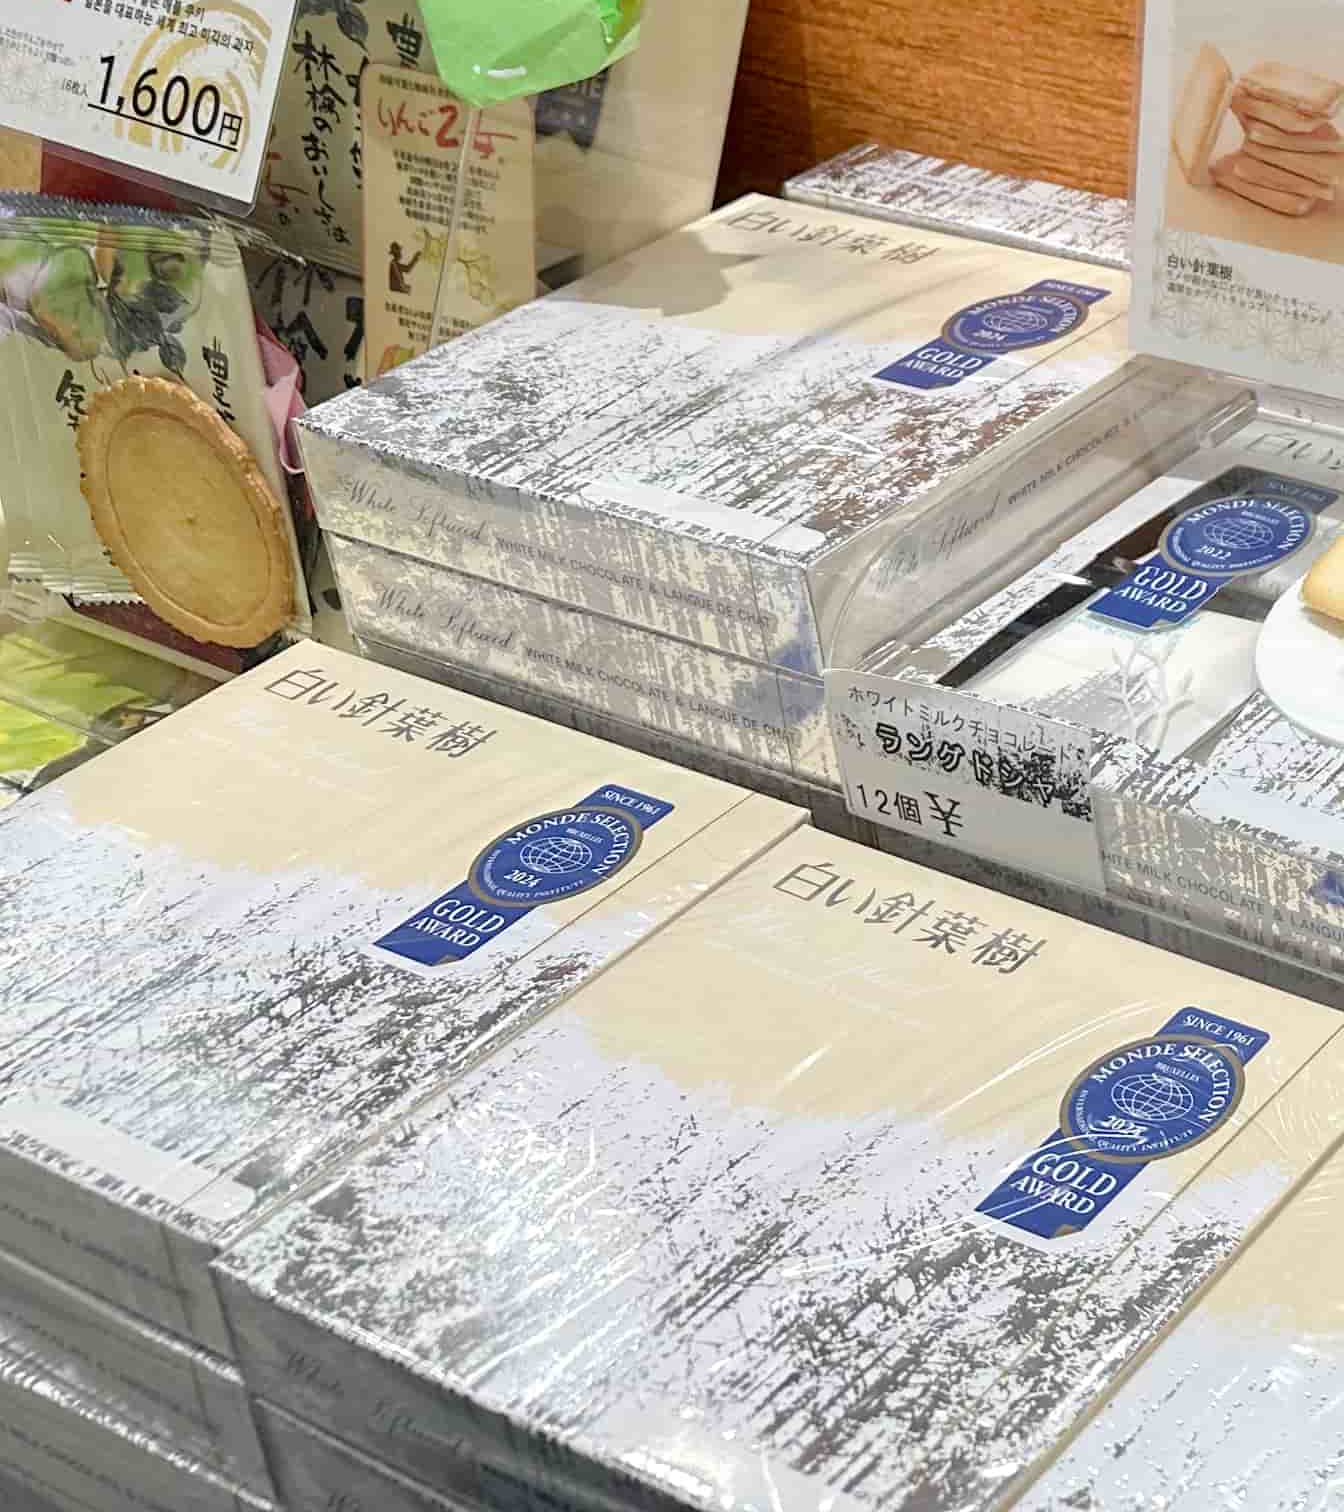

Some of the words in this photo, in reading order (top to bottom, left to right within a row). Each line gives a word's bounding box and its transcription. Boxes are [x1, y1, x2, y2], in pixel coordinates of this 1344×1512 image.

[100, 55, 244, 146] 1,600円
[902, 357, 965, 380] AWARD
[915, 346, 985, 371] GOLD
[1113, 584, 1188, 614] AWARD
[1133, 565, 1209, 601] GOLD
[263, 665, 497, 758] 白い針葉樹
[601, 789, 637, 809] SINCE
[856, 783, 923, 825] 12個
[507, 811, 592, 846] MONDE
[588, 813, 631, 876] SELECTION
[502, 868, 545, 889] 2024
[1177, 874, 1266, 916] CHOCOLATE
[408, 916, 482, 948] AWARD
[431, 897, 506, 935] GOLD
[772, 861, 1051, 977] 白い針葉樹
[1183, 1012, 1226, 1038] SINCE
[1225, 1027, 1256, 1047] 1961
[1090, 1042, 1177, 1084] MONDE
[1180, 1043, 1233, 1124] SELECTION
[1031, 1151, 1118, 1198] GOLD
[1009, 1174, 1096, 1216] AWARD
